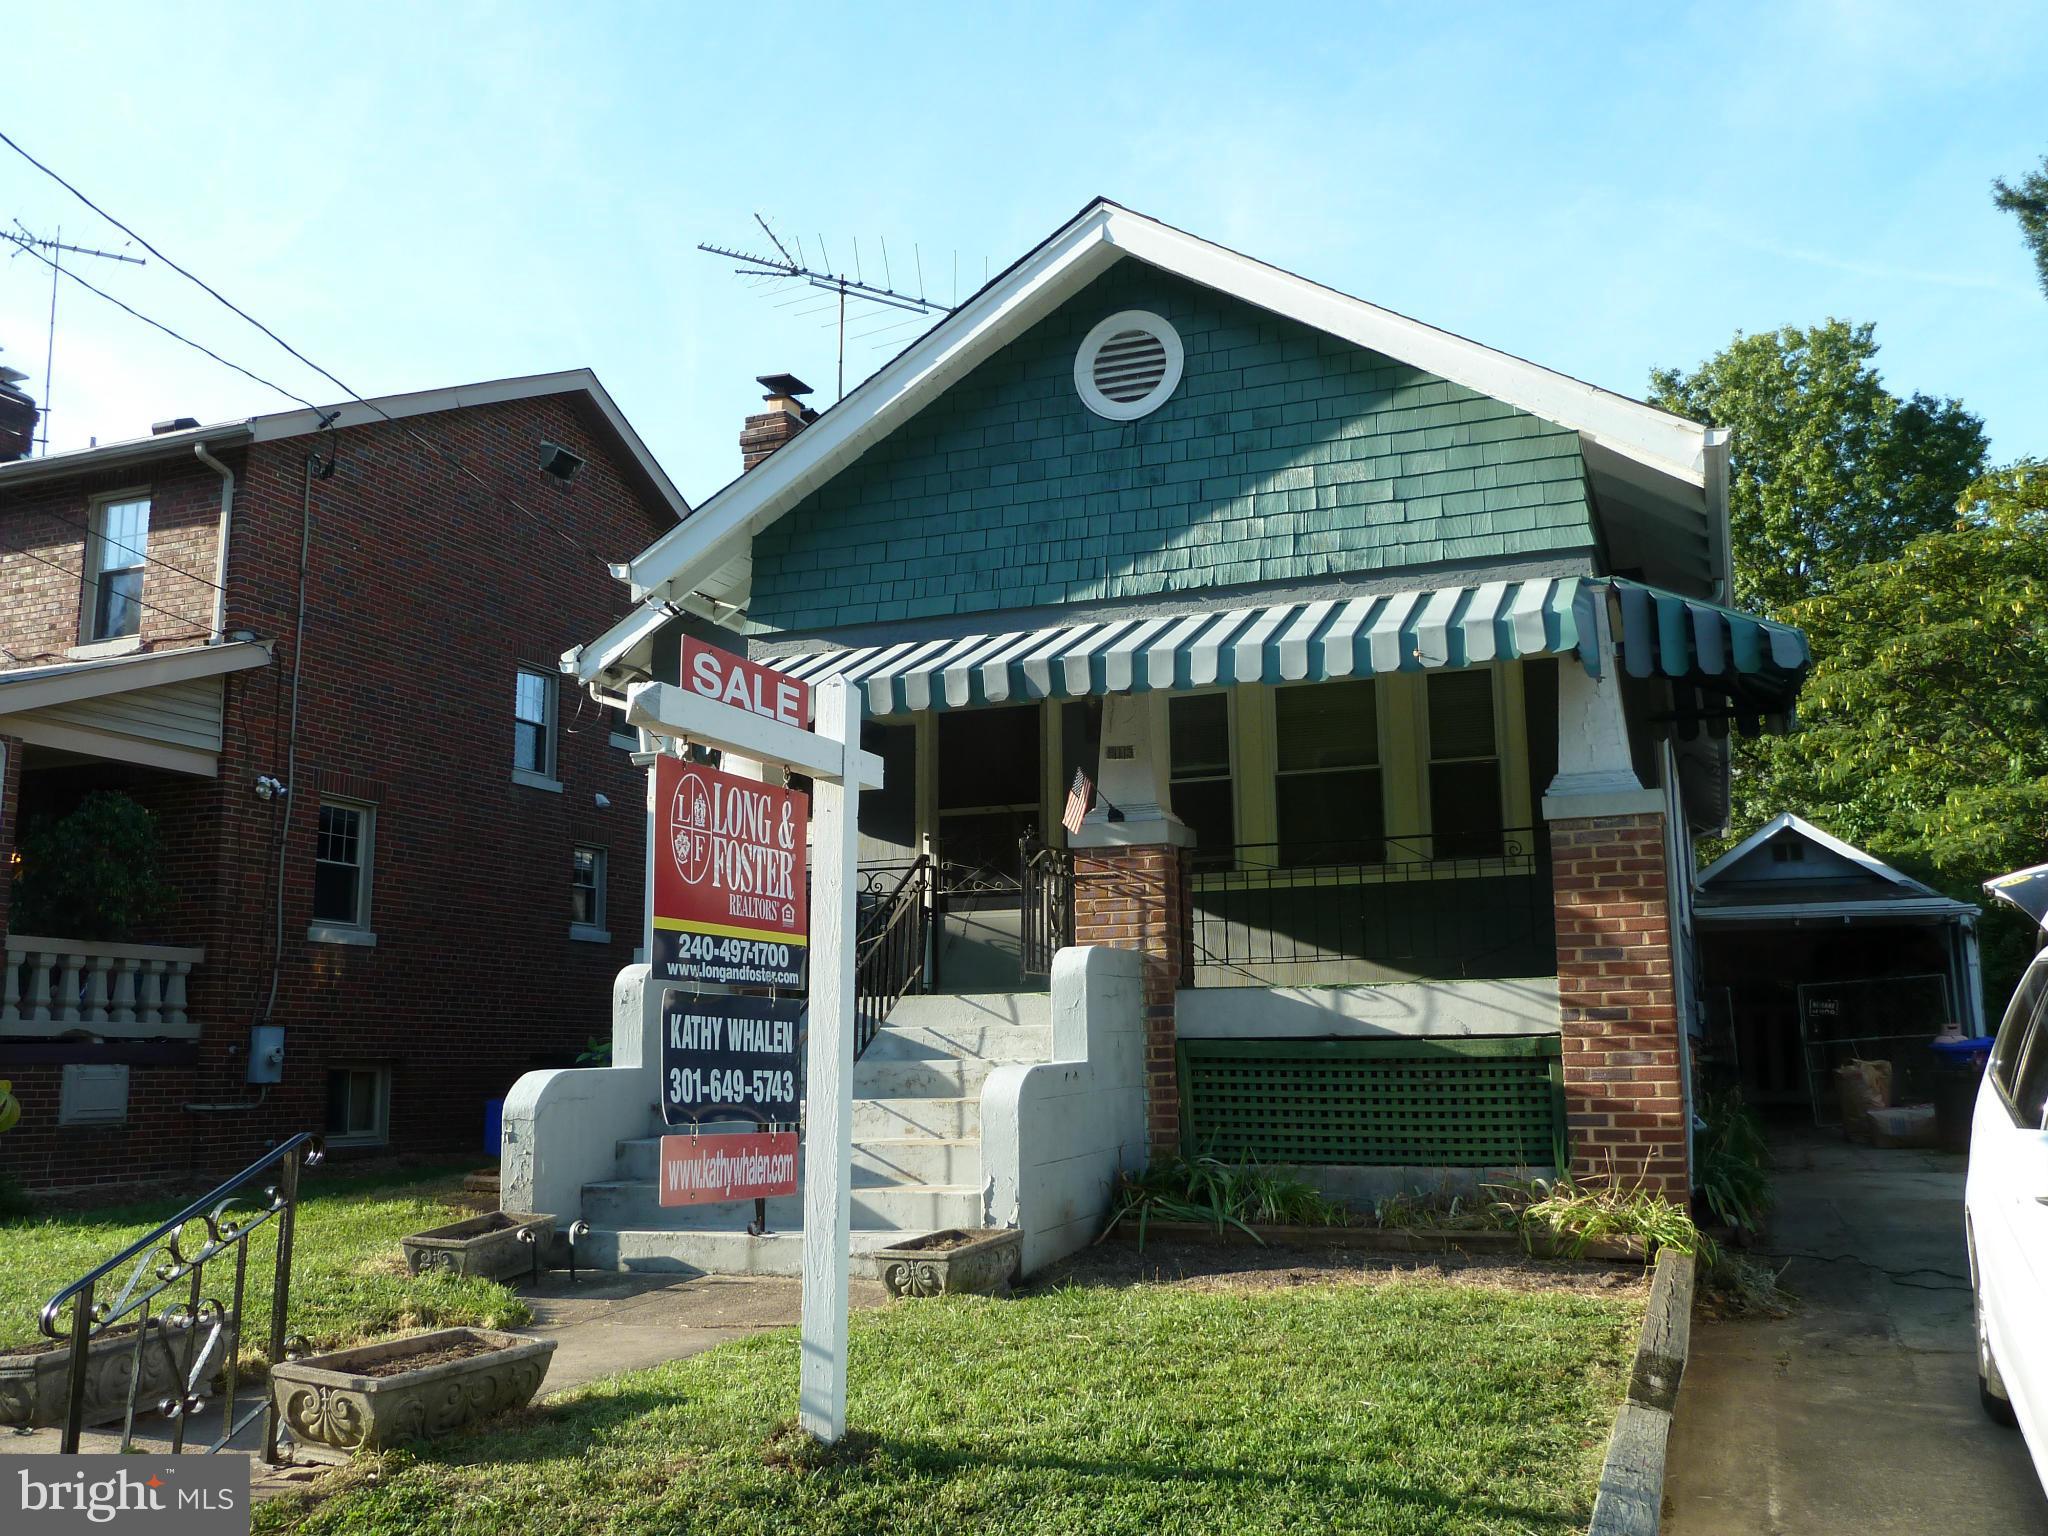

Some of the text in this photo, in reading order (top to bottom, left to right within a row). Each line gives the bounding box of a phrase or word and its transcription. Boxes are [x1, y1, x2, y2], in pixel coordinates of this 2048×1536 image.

[692, 652, 800, 727] SALE
[677, 794, 691, 823] L
[712, 782, 795, 850] LONG &
[694, 835, 706, 862] F
[712, 836, 796, 901] FOSTER
[728, 893, 778, 922] REALTORS
[678, 933, 789, 968] 240-497-1700
[666, 961, 799, 985] www.longandfoster.com
[670, 1013, 793, 1054] KATHY WHALEN
[669, 1067, 794, 1104] 301-649-5743
[668, 1147, 794, 1192] www.kathywhalen.com
